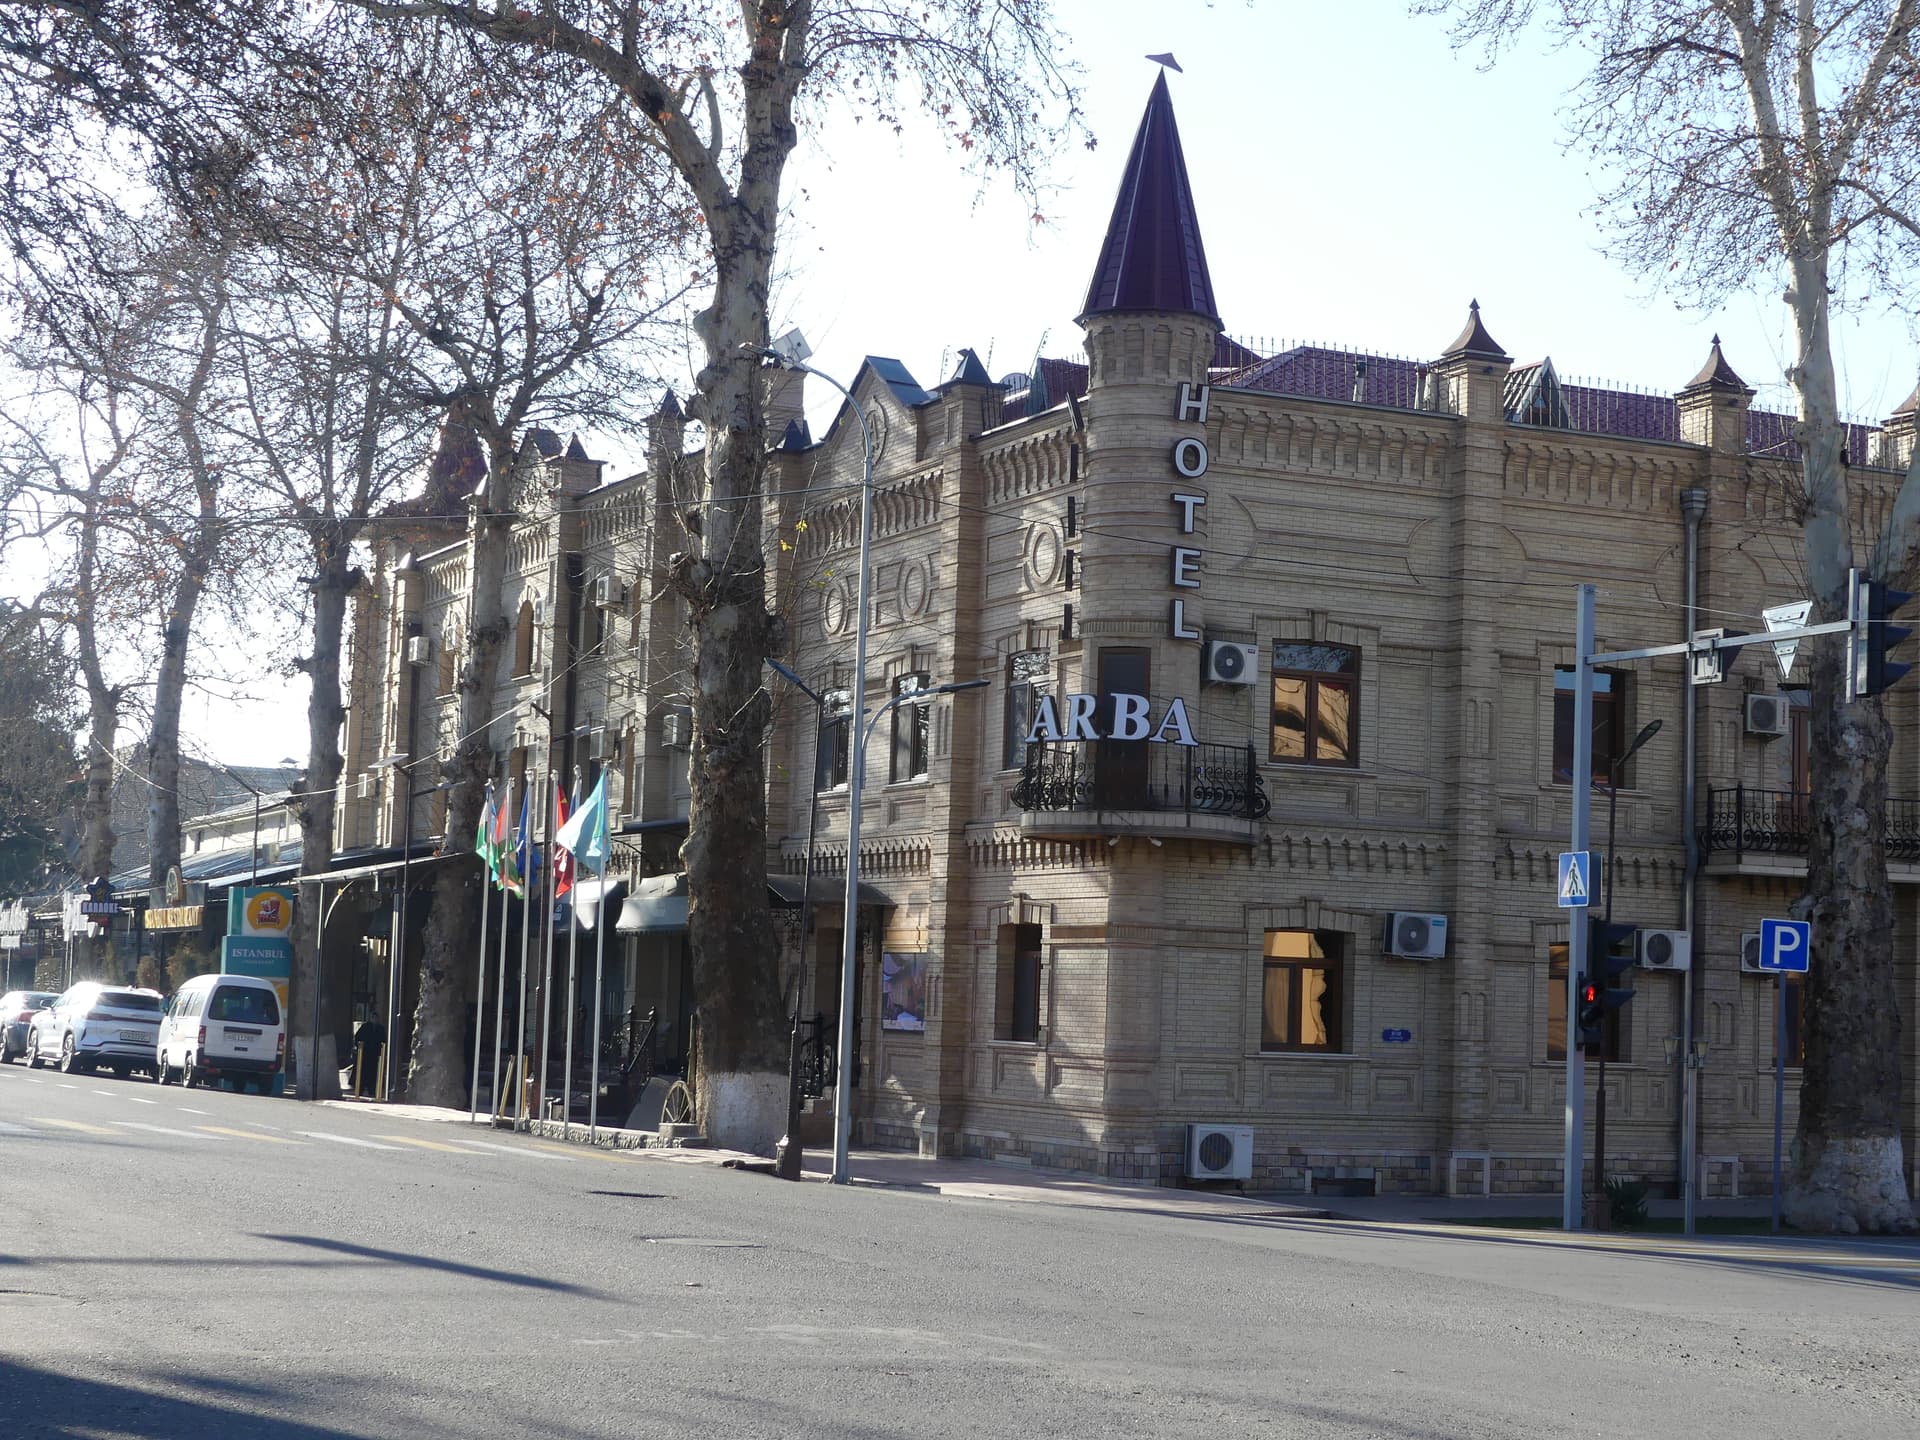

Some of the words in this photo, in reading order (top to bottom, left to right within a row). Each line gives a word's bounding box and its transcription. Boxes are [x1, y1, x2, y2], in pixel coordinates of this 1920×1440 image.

[1173, 382, 1209, 640] HOTEL
[1025, 691, 1199, 746] ARBA
[1773, 927, 1800, 964] P
